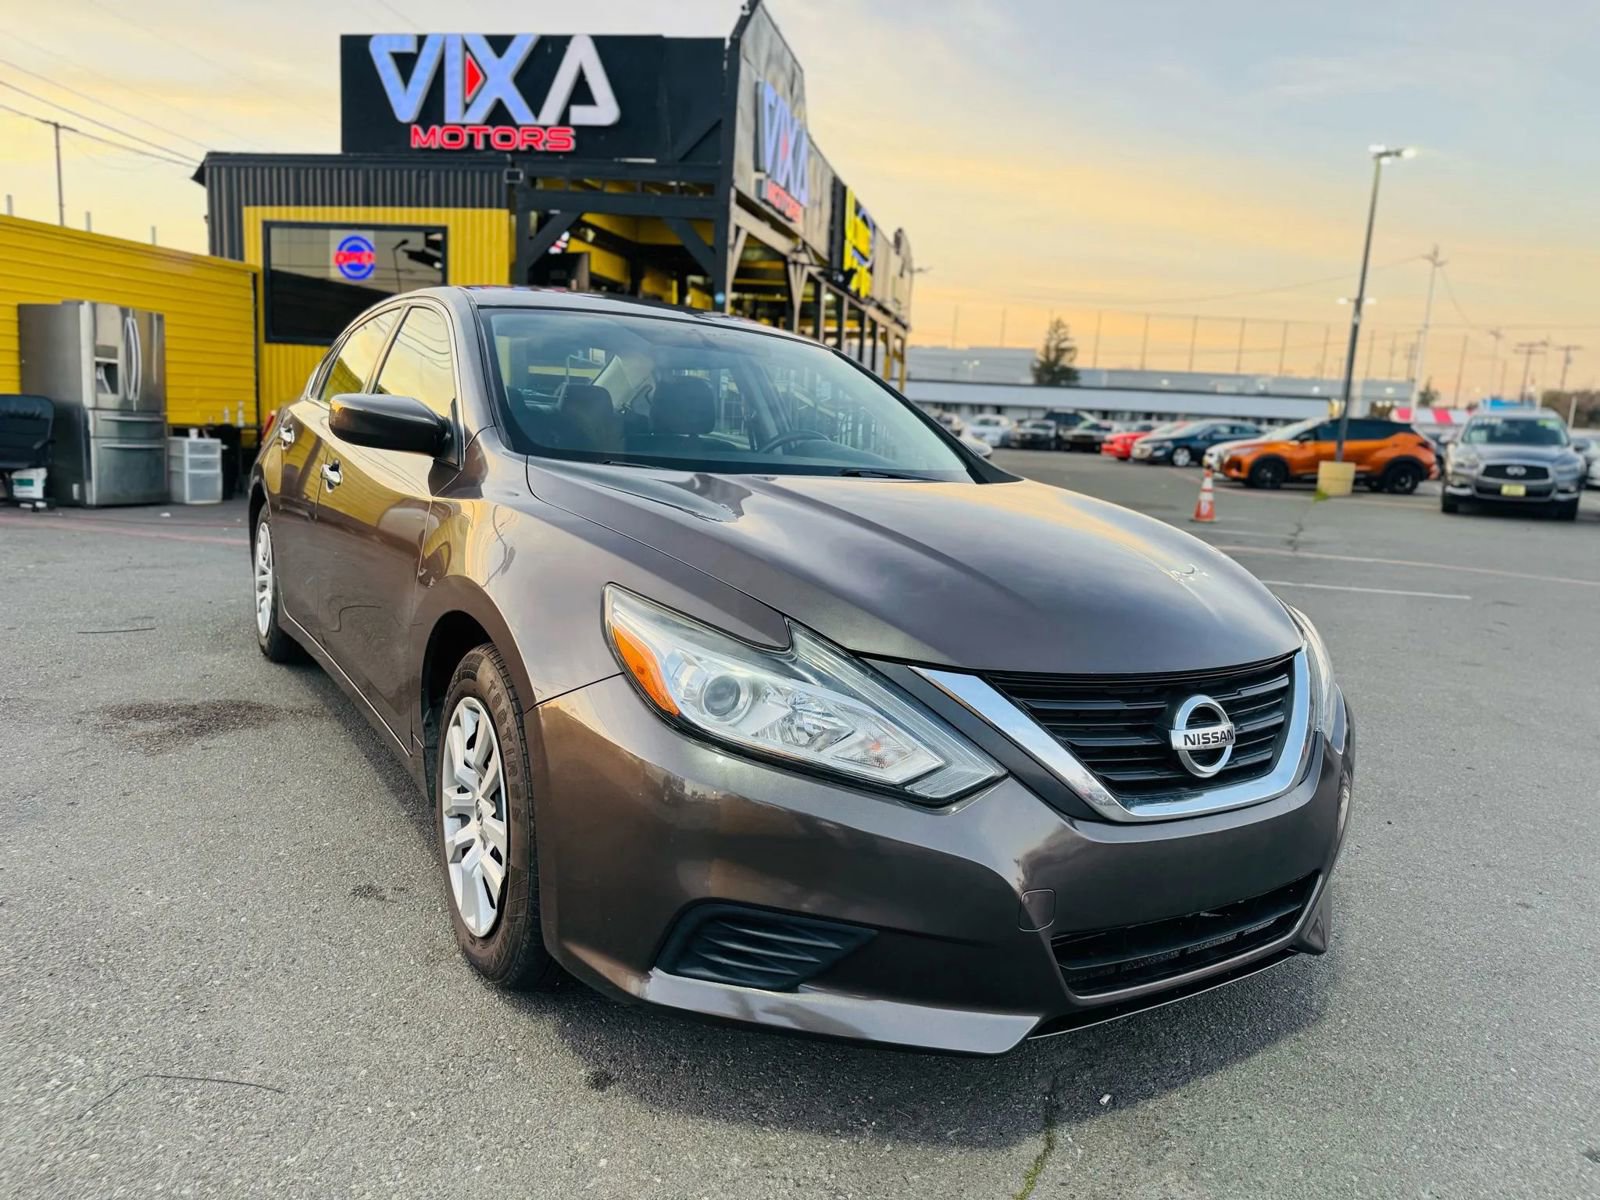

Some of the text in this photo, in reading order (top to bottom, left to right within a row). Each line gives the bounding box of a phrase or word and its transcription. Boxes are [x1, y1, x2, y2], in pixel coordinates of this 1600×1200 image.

[369, 34, 620, 126] VIXA
[410, 124, 576, 152] MOTORS
[1184, 729, 1234, 746] NISSAN
